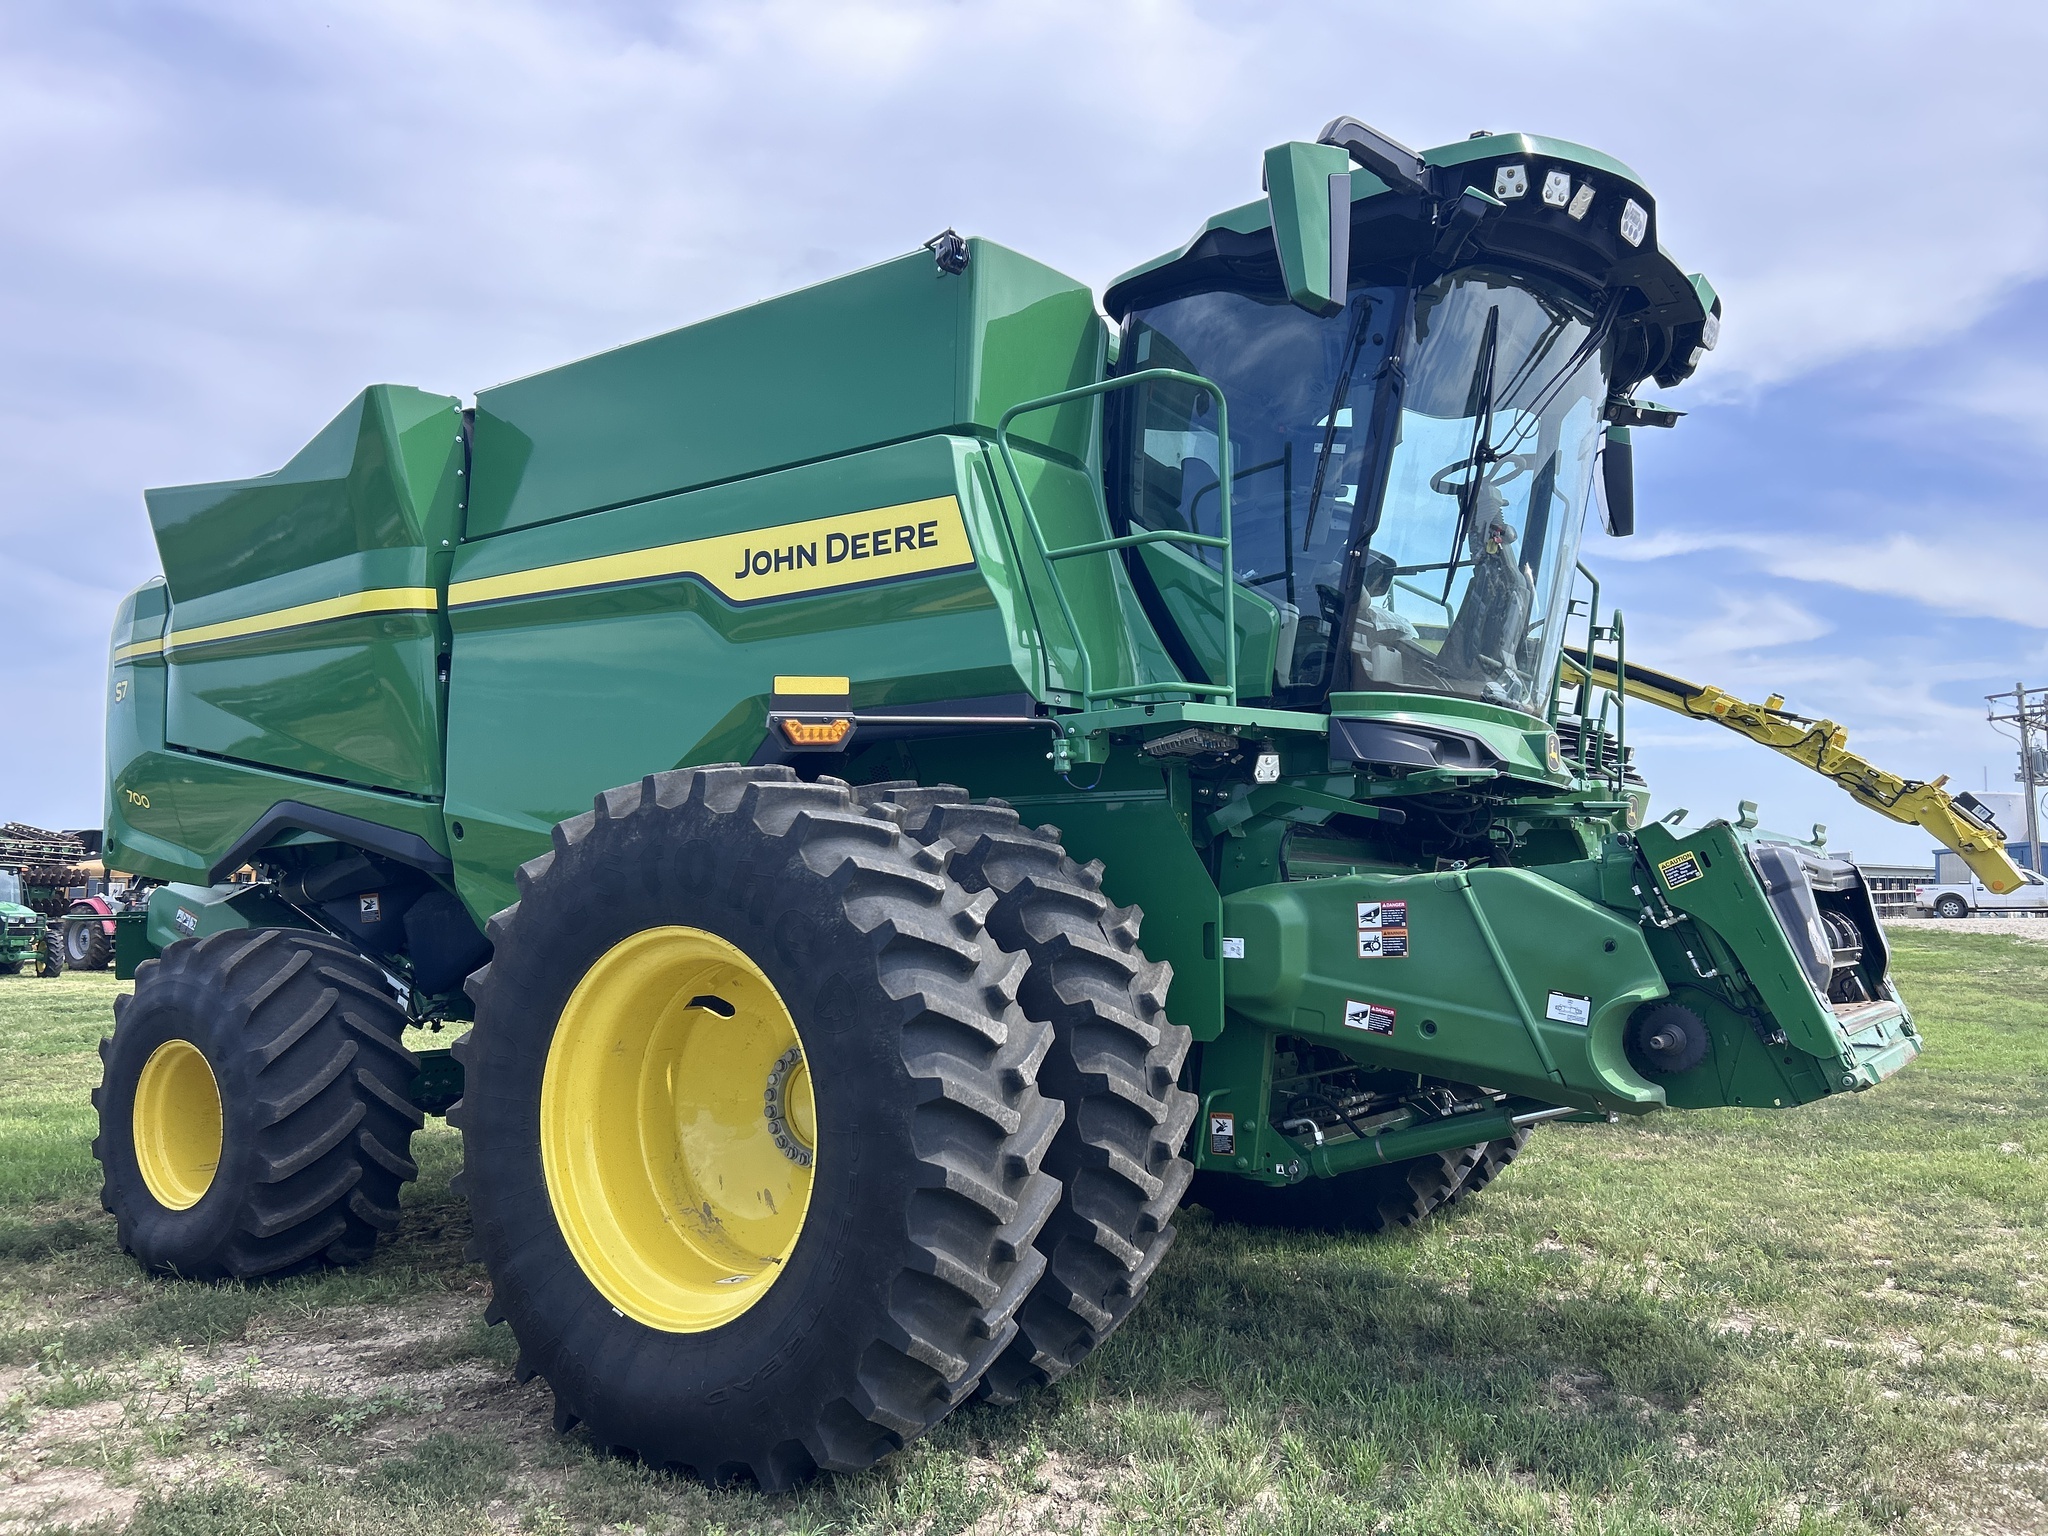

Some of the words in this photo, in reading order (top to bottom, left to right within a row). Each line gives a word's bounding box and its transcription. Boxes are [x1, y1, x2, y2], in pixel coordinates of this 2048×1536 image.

[735, 542, 817, 579] JOHN
[826, 520, 938, 564] DEERE
[115, 680, 128, 703] S7
[126, 789, 151, 809] 700
[1665, 853, 1692, 867] CAUTION
